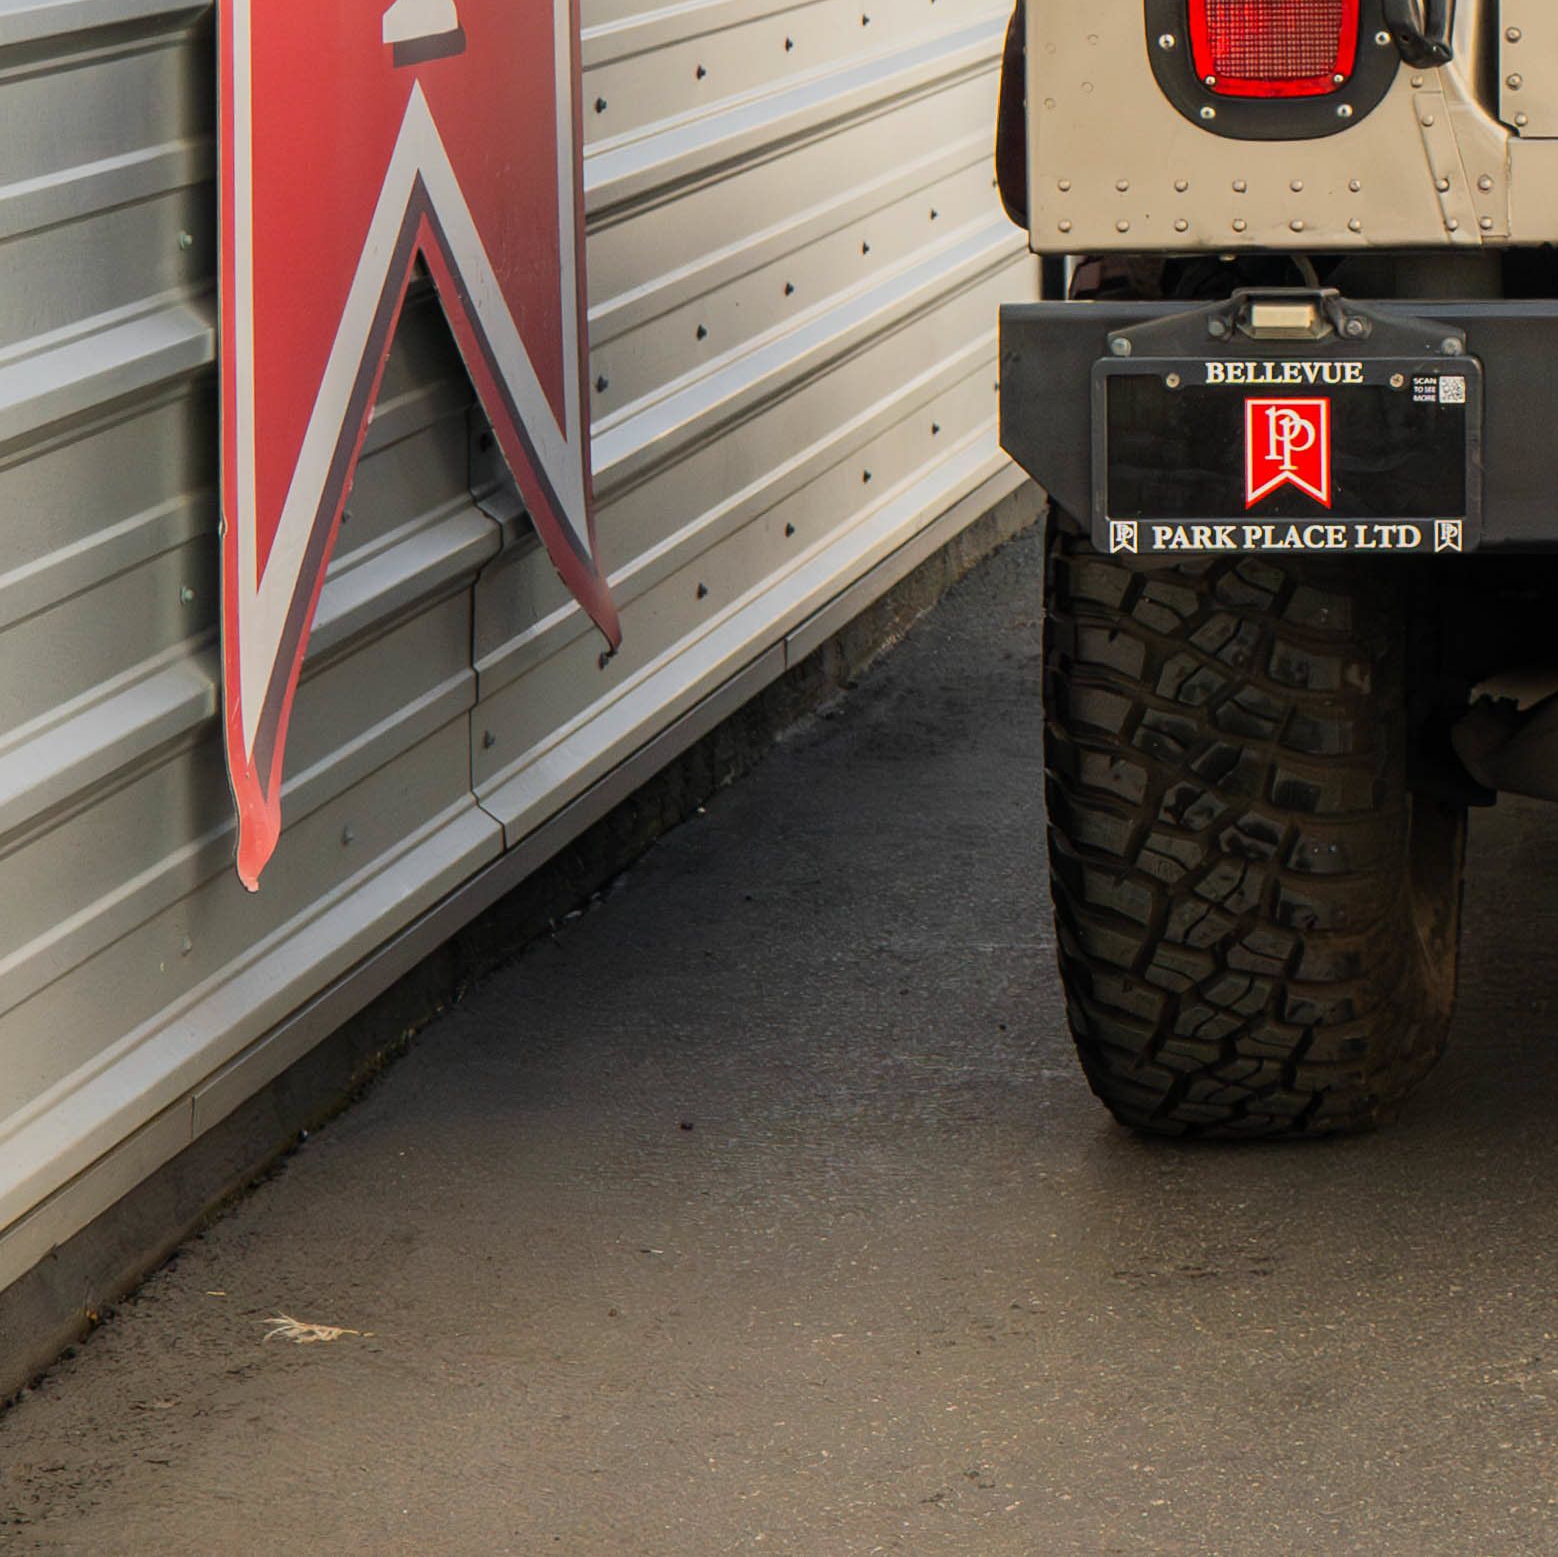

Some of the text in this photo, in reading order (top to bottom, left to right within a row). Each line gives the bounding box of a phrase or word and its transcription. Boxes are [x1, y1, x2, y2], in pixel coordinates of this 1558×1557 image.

[1205, 361, 1364, 385] BELLEVUE
[1413, 377, 1437, 385] SCAN
[1413, 394, 1437, 402] MORE
[1152, 525, 1238, 550] PARK
[1242, 525, 1348, 550] PLACE
[1354, 524, 1423, 549] LTD
